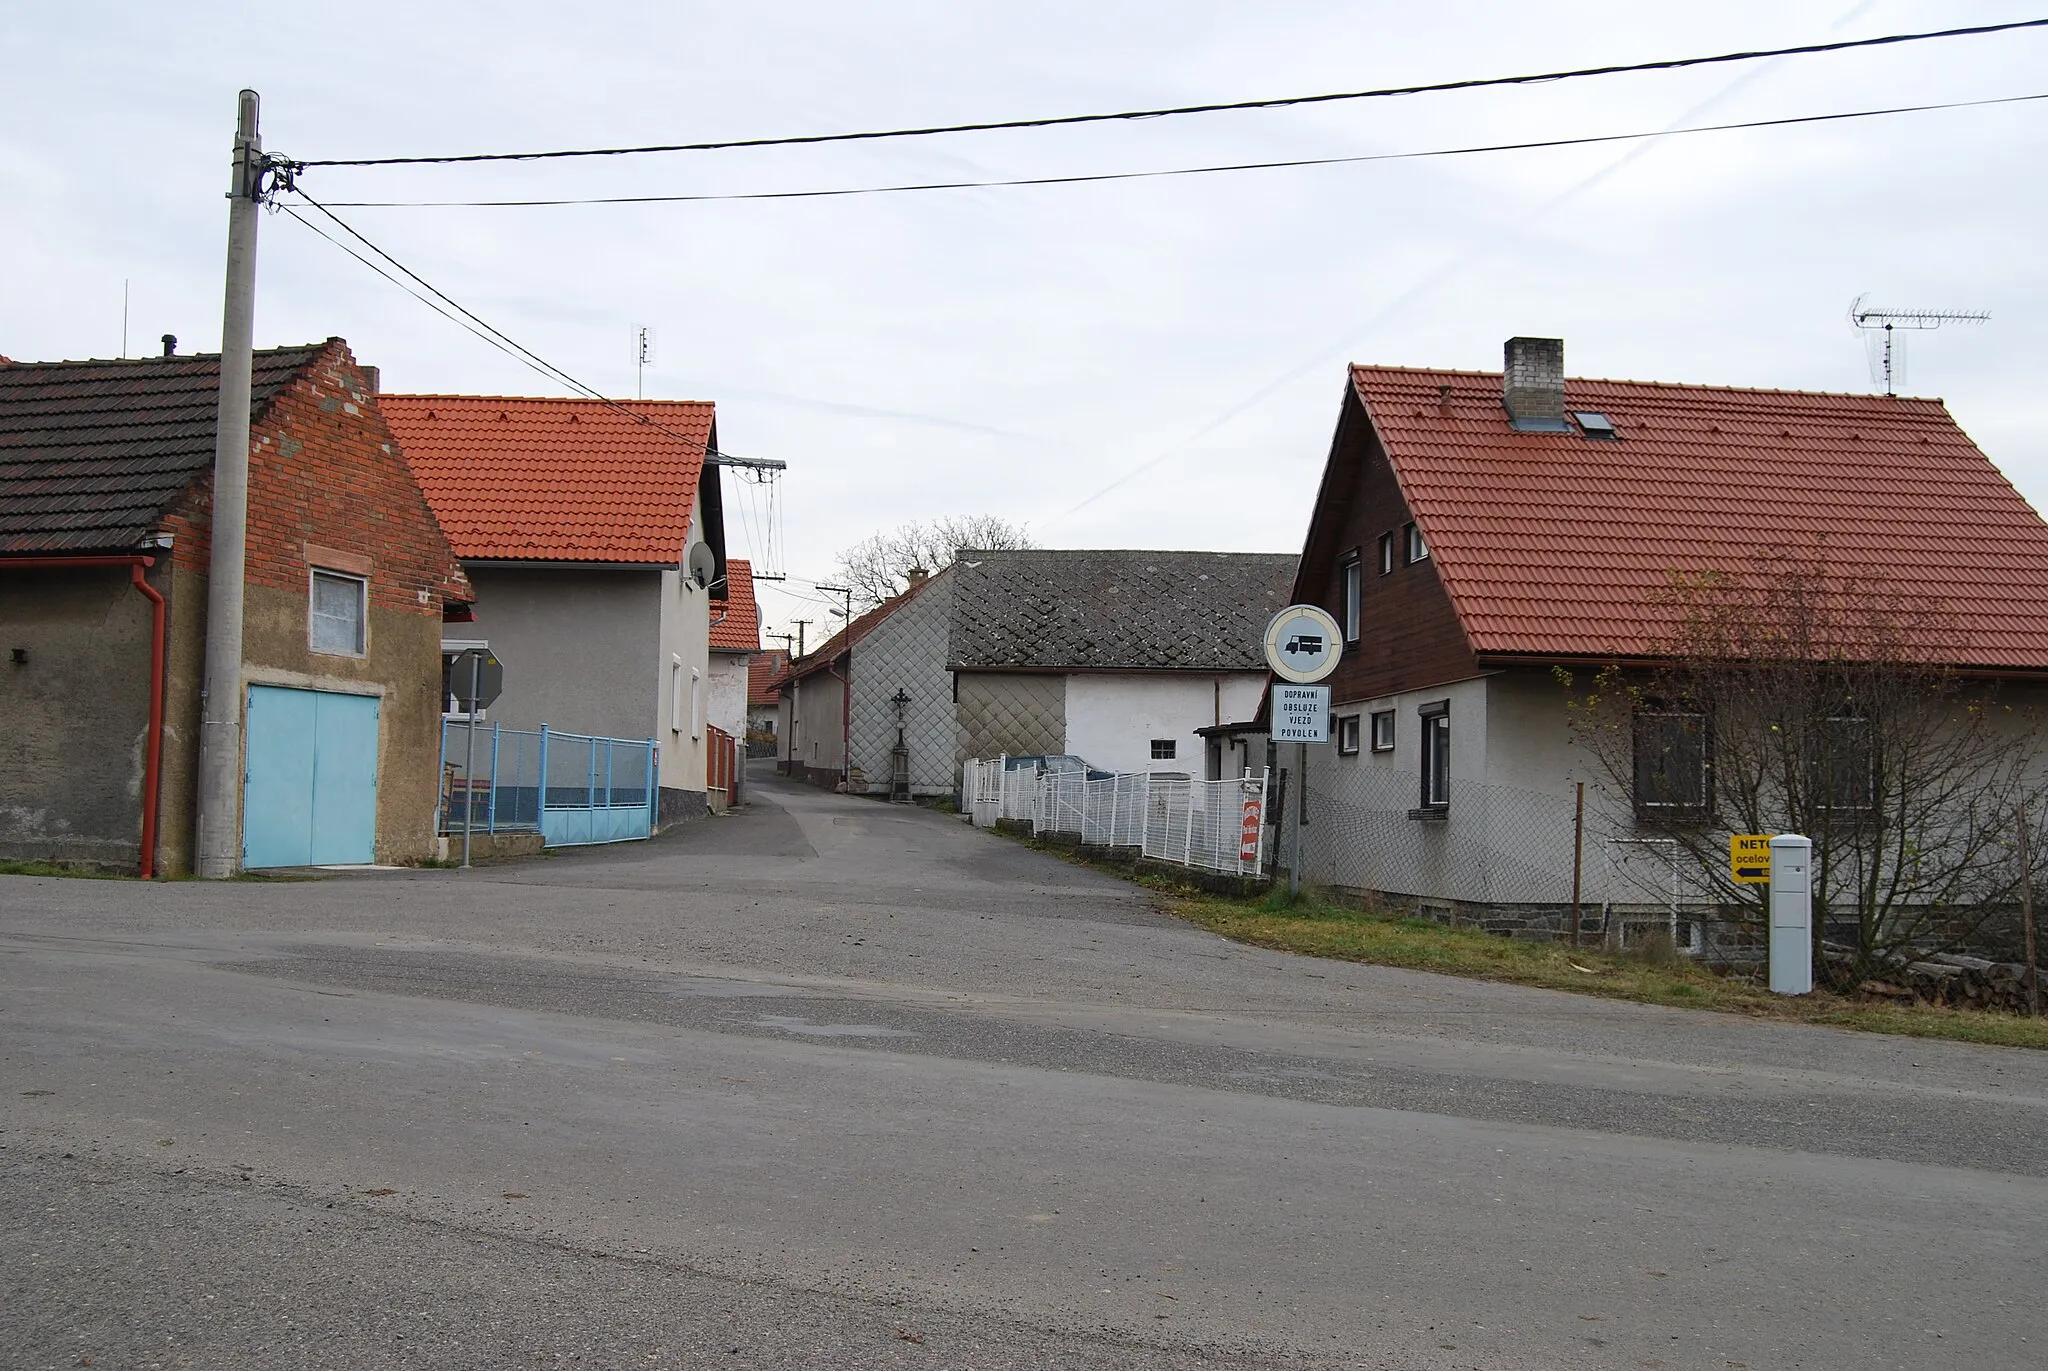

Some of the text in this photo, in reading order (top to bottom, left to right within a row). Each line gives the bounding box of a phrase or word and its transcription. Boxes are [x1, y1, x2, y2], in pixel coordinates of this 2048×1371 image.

[1284, 689, 1318, 699] DOPRAVNÍ
[1283, 703, 1317, 712] OBSLUZE
[1289, 716, 1312, 725] VJEZD
[1281, 728, 1318, 738] POVOLEN
